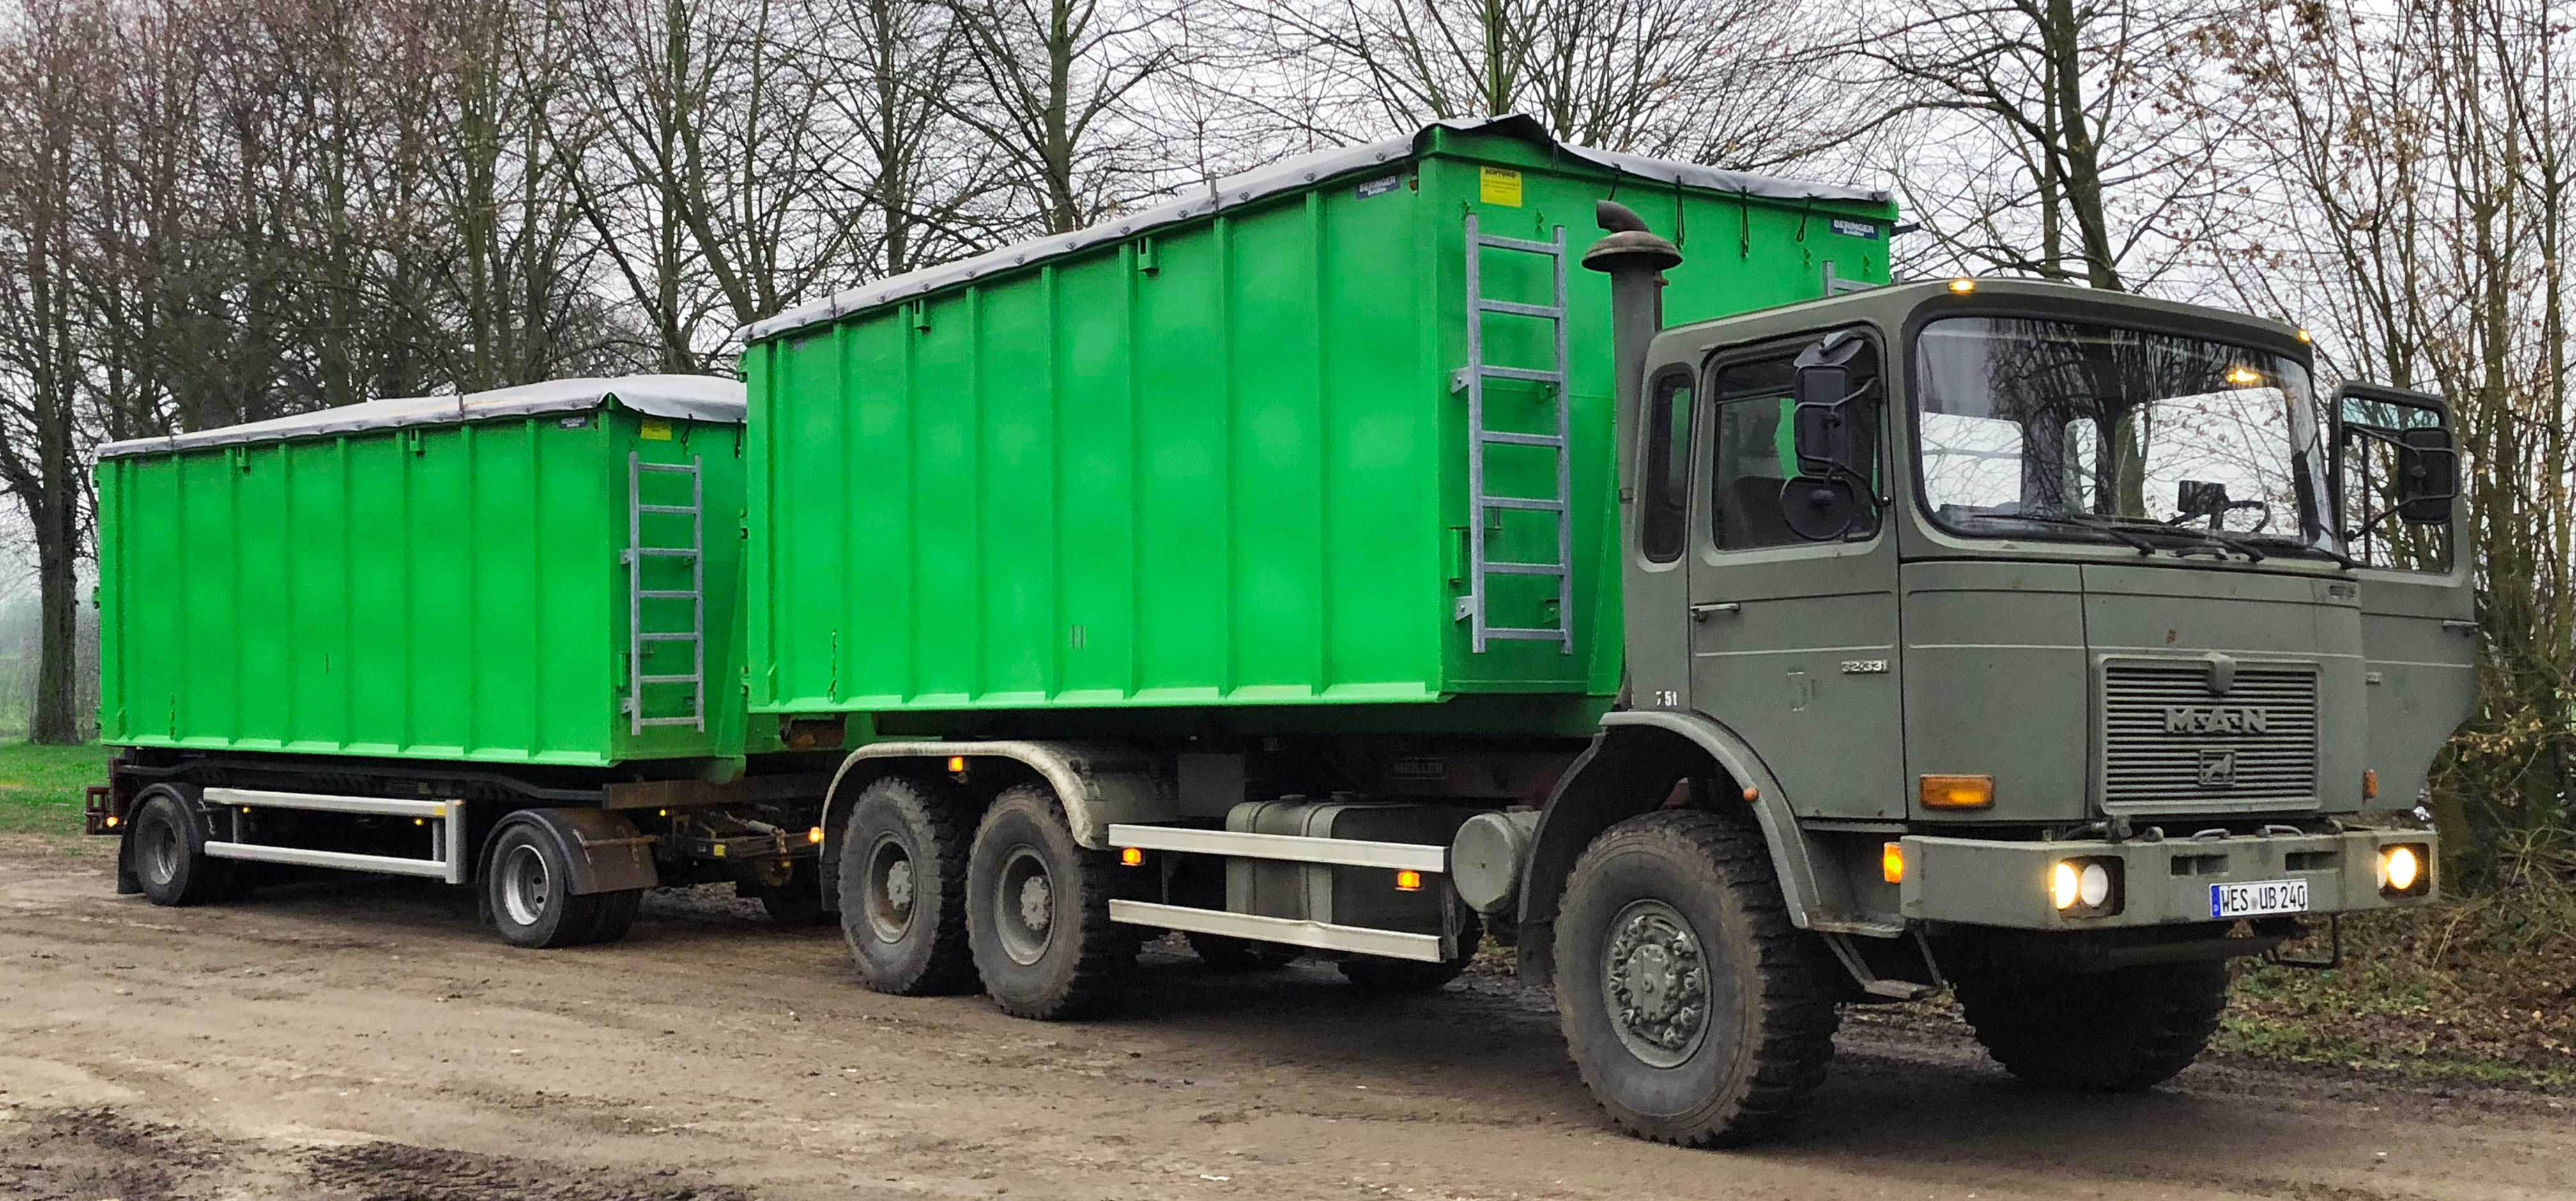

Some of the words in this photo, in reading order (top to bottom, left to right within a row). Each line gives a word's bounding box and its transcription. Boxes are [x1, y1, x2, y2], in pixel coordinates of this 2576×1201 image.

[2221, 888, 2248, 912] WES
[2259, 886, 2277, 910] UB
[2280, 885, 2306, 909] 240
